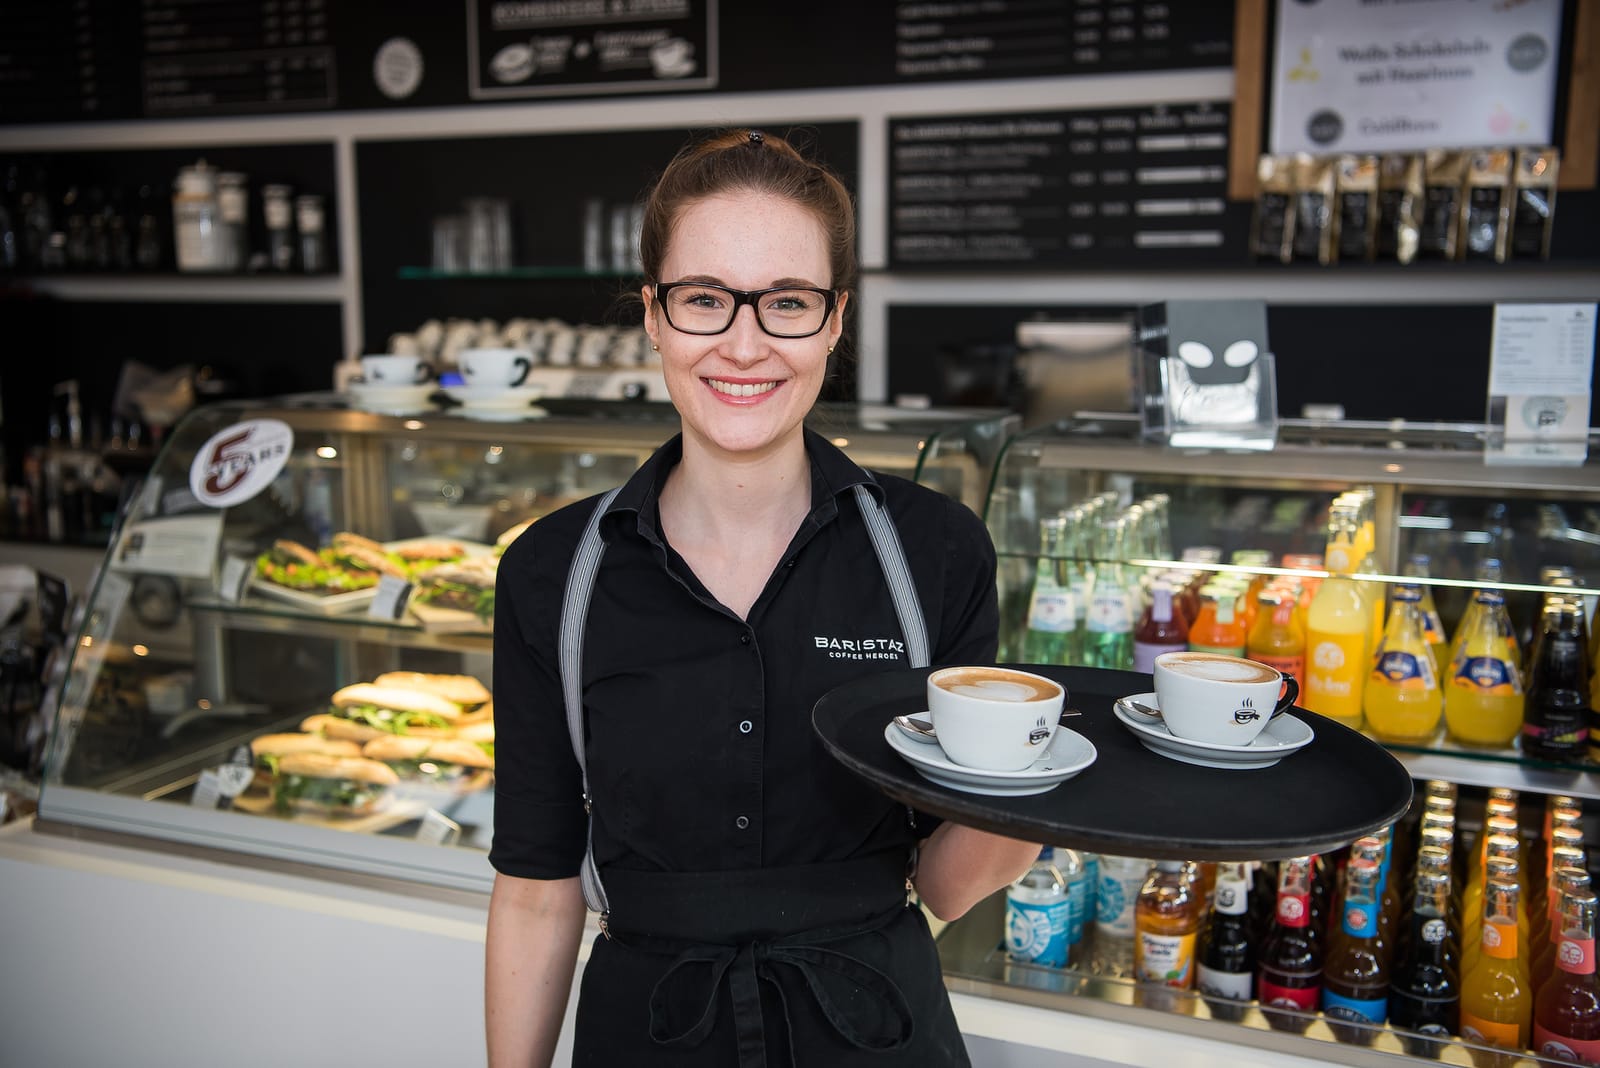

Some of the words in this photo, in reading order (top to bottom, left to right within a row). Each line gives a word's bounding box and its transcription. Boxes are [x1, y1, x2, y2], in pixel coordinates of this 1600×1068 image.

[205, 427, 256, 496] 5
[814, 636, 904, 653] BARISTAZ
[829, 651, 863, 660] COFFEE
[865, 652, 899, 660] HEROES
